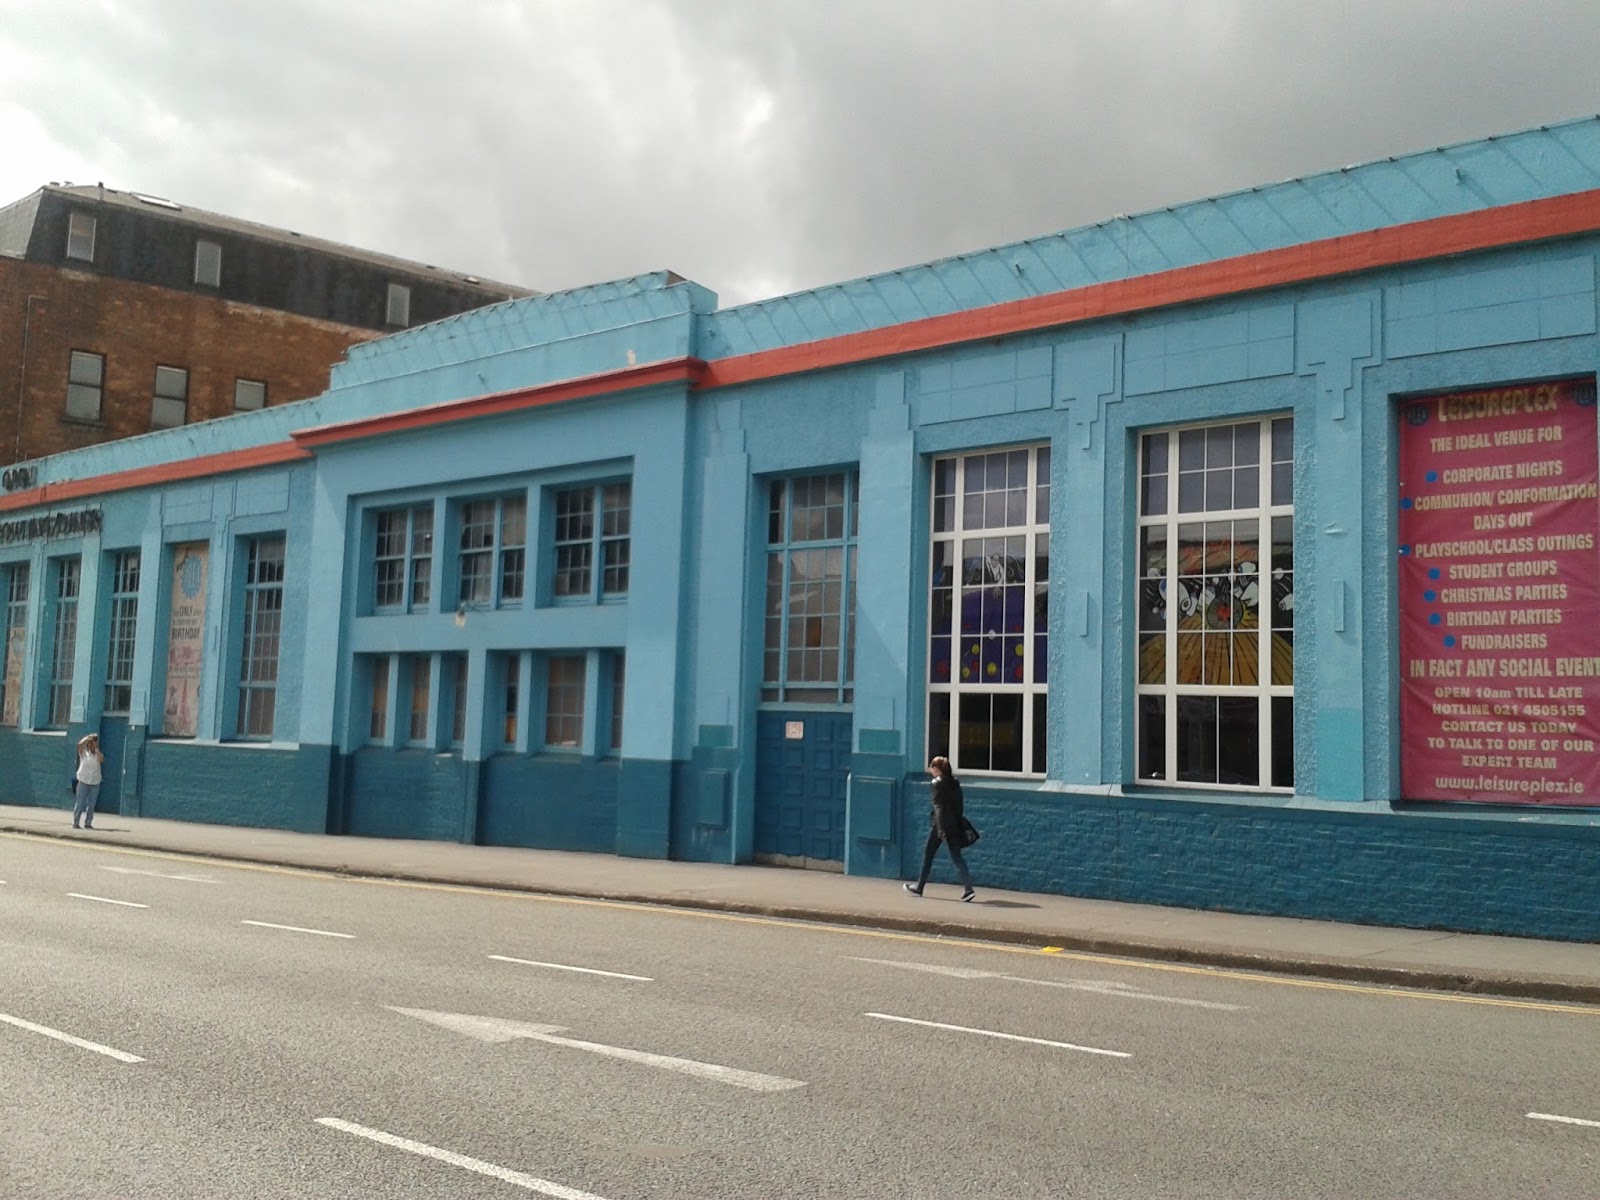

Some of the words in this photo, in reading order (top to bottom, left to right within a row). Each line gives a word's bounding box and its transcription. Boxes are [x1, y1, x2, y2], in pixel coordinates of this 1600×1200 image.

[1431, 437, 1452, 453] THE
[1456, 434, 1490, 450] IDEAL
[1494, 430, 1534, 446] VENUE
[1538, 426, 1562, 442] FOR
[1443, 465, 1513, 484] CORPORATE
[1517, 461, 1563, 477] NIGHTS
[1498, 483, 1597, 505] CONFORMATION
[1474, 515, 1505, 530] DAYS
[1509, 512, 1533, 527] OUT
[1415, 537, 1533, 558] PLAYSCHOOL/CLASS
[1537, 534, 1593, 550] OUTINGS
[1449, 563, 1504, 580] STUDENT
[1507, 560, 1558, 577] GROUPS
[1441, 587, 1512, 603] CHRISTMAS
[1516, 584, 1567, 600] PARTIES
[1447, 611, 1506, 626] BIRTHDAY
[1510, 609, 1561, 625] PARTIES
[1462, 634, 1547, 649] FUNDRAISERS
[1410, 660, 1424, 677] IN
[1429, 660, 1462, 677] FACT
[1467, 659, 1495, 677] ANY
[1499, 658, 1551, 677] SOCIAL
[1435, 687, 1470, 699] OPEN
[1475, 687, 1511, 699] 10am
[1515, 687, 1544, 699] TILL
[1549, 687, 1583, 698] LATE
[1432, 704, 1489, 715] HOTLINE
[1494, 705, 1518, 715] 021
[1441, 721, 1504, 732] CONTACT
[1508, 722, 1526, 732] US
[1530, 722, 1577, 733] TODAY
[1427, 737, 1444, 749] TO
[1448, 738, 1483, 749] TALK
[1486, 738, 1503, 750] TO
[1508, 739, 1536, 751] ONE
[1541, 740, 1559, 751] OF
[1563, 739, 1594, 752] OUR
[1462, 755, 1512, 768] EXPERT
[1517, 756, 1557, 769] TEAM
[1435, 775, 1584, 795] www.leisureplex.ie
